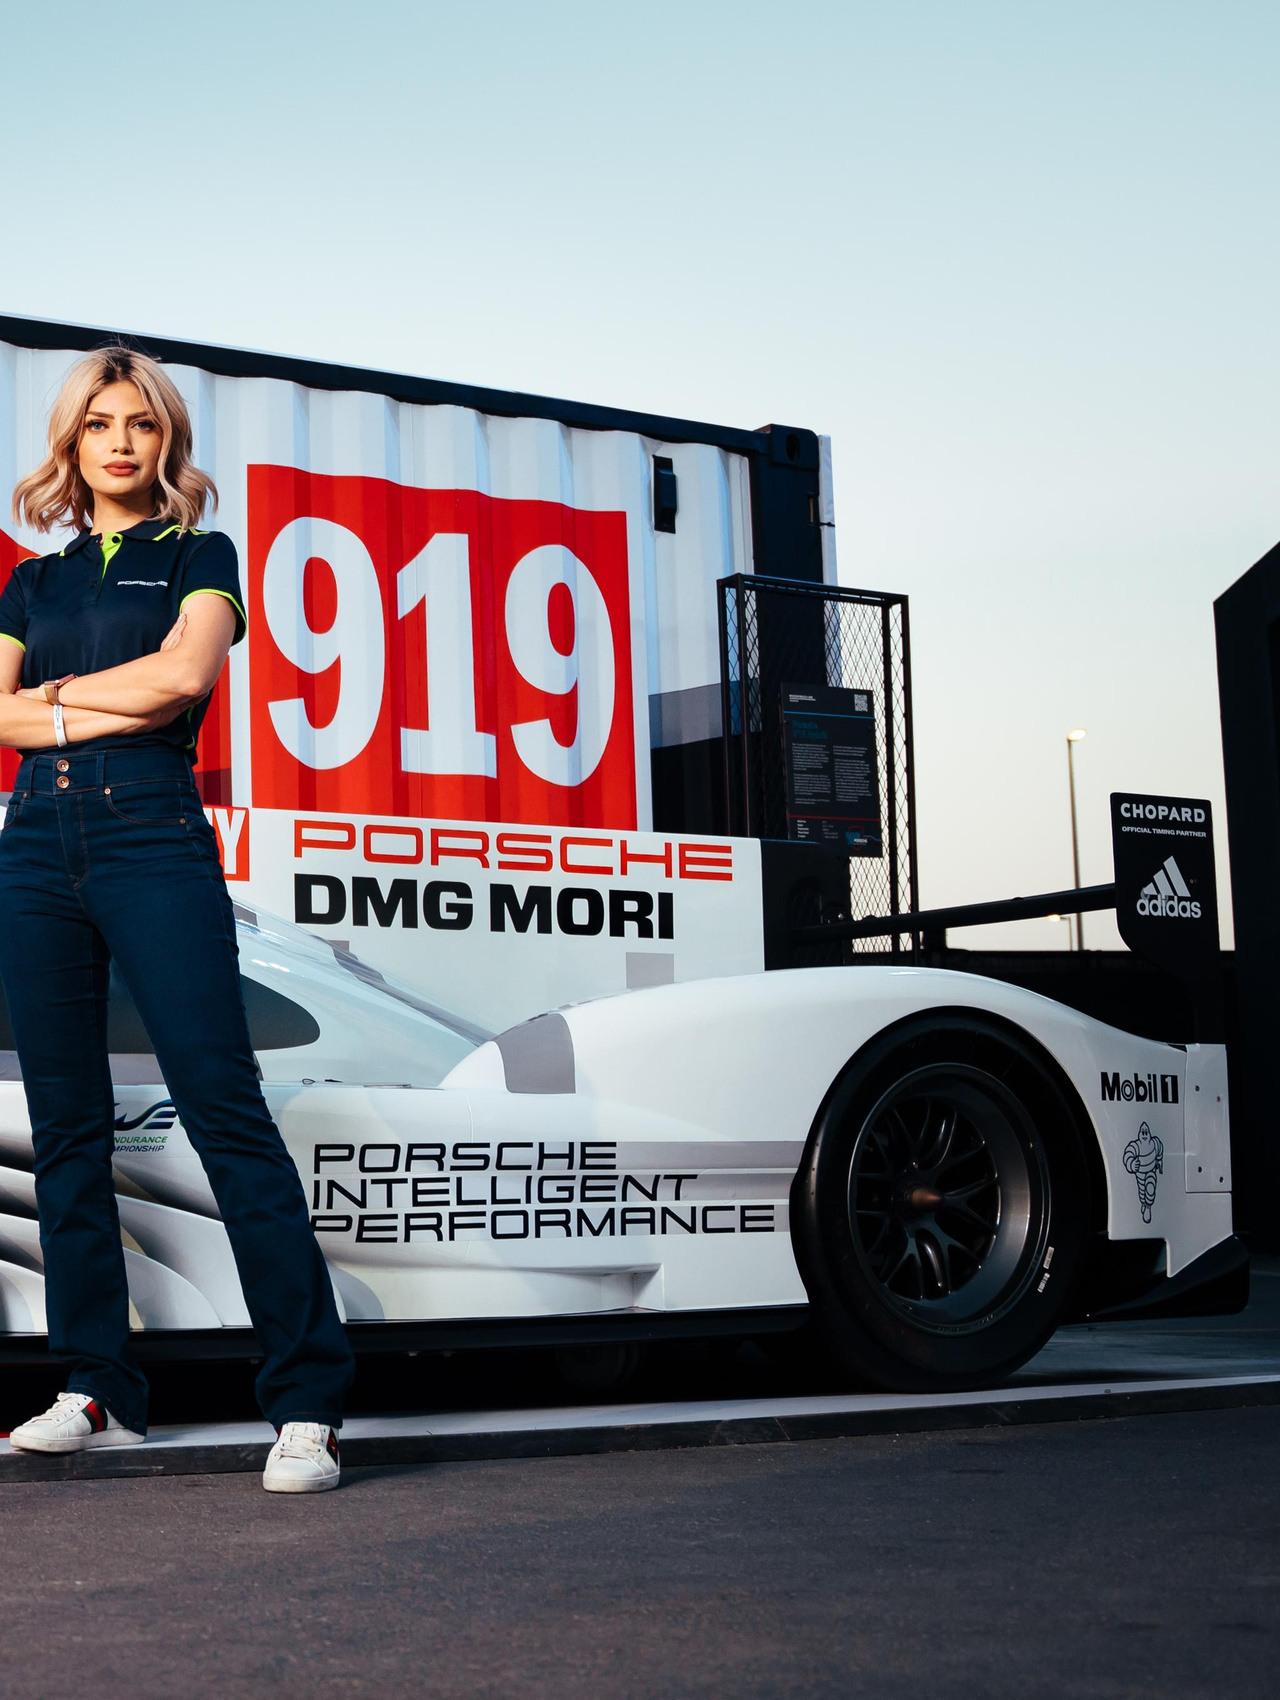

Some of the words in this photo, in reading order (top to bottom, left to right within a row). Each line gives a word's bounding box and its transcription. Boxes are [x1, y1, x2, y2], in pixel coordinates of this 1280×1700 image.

[263, 516, 616, 788] 919
[1120, 803, 1206, 823] CHOPARD
[1122, 826, 1152, 834] OFFICIAL
[1152, 828, 1175, 836] TIMING
[1176, 829, 1207, 838] PARTNER
[294, 819, 733, 882] PORSCHE
[294, 873, 475, 931] DMG
[489, 882, 675, 940] MORI
[1136, 893, 1202, 919] adidas
[1100, 1071, 1159, 1103] Mobil
[113, 1136, 168, 1144] NDURANCE
[313, 1141, 618, 1175] PORSCHE
[312, 1174, 699, 1210] INTELLIGENT
[310, 1204, 776, 1244] PERFORMANCE
